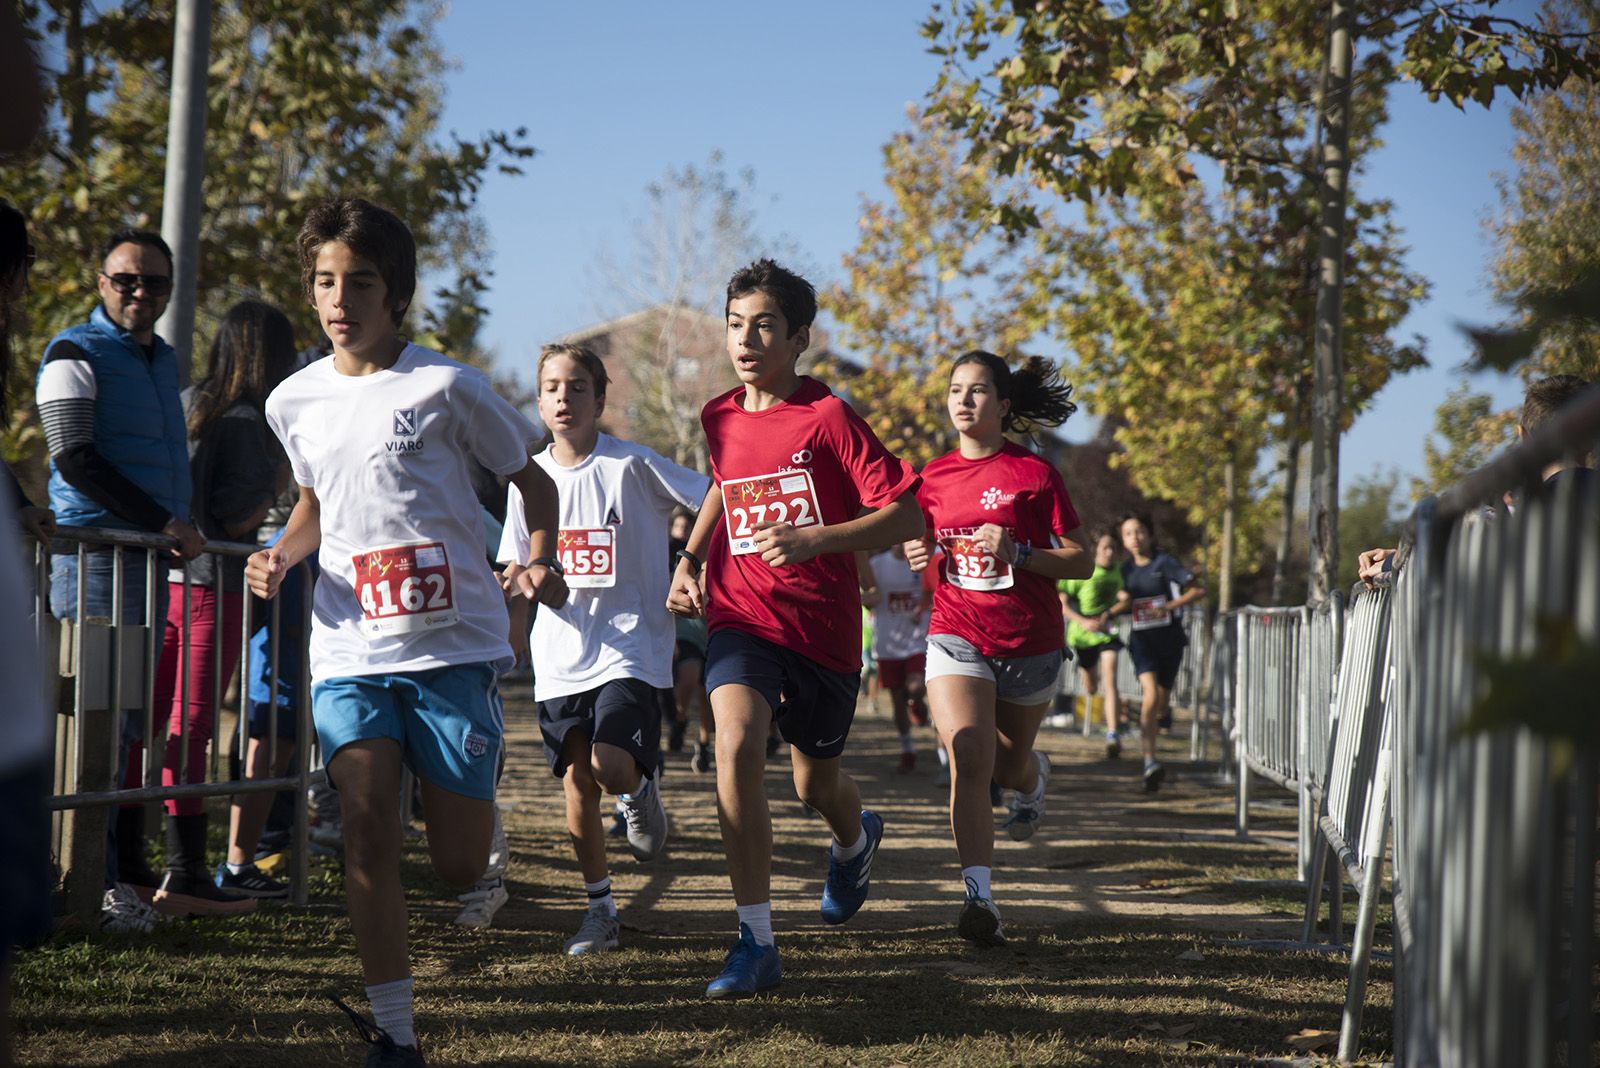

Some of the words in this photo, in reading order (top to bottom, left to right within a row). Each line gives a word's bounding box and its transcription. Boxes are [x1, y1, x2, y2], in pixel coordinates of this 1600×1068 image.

[385, 437, 424, 451] VIARÓ
[732, 498, 815, 537] 2722
[557, 549, 610, 574] 459
[956, 553, 998, 577] 352
[361, 573, 448, 616] 4162
